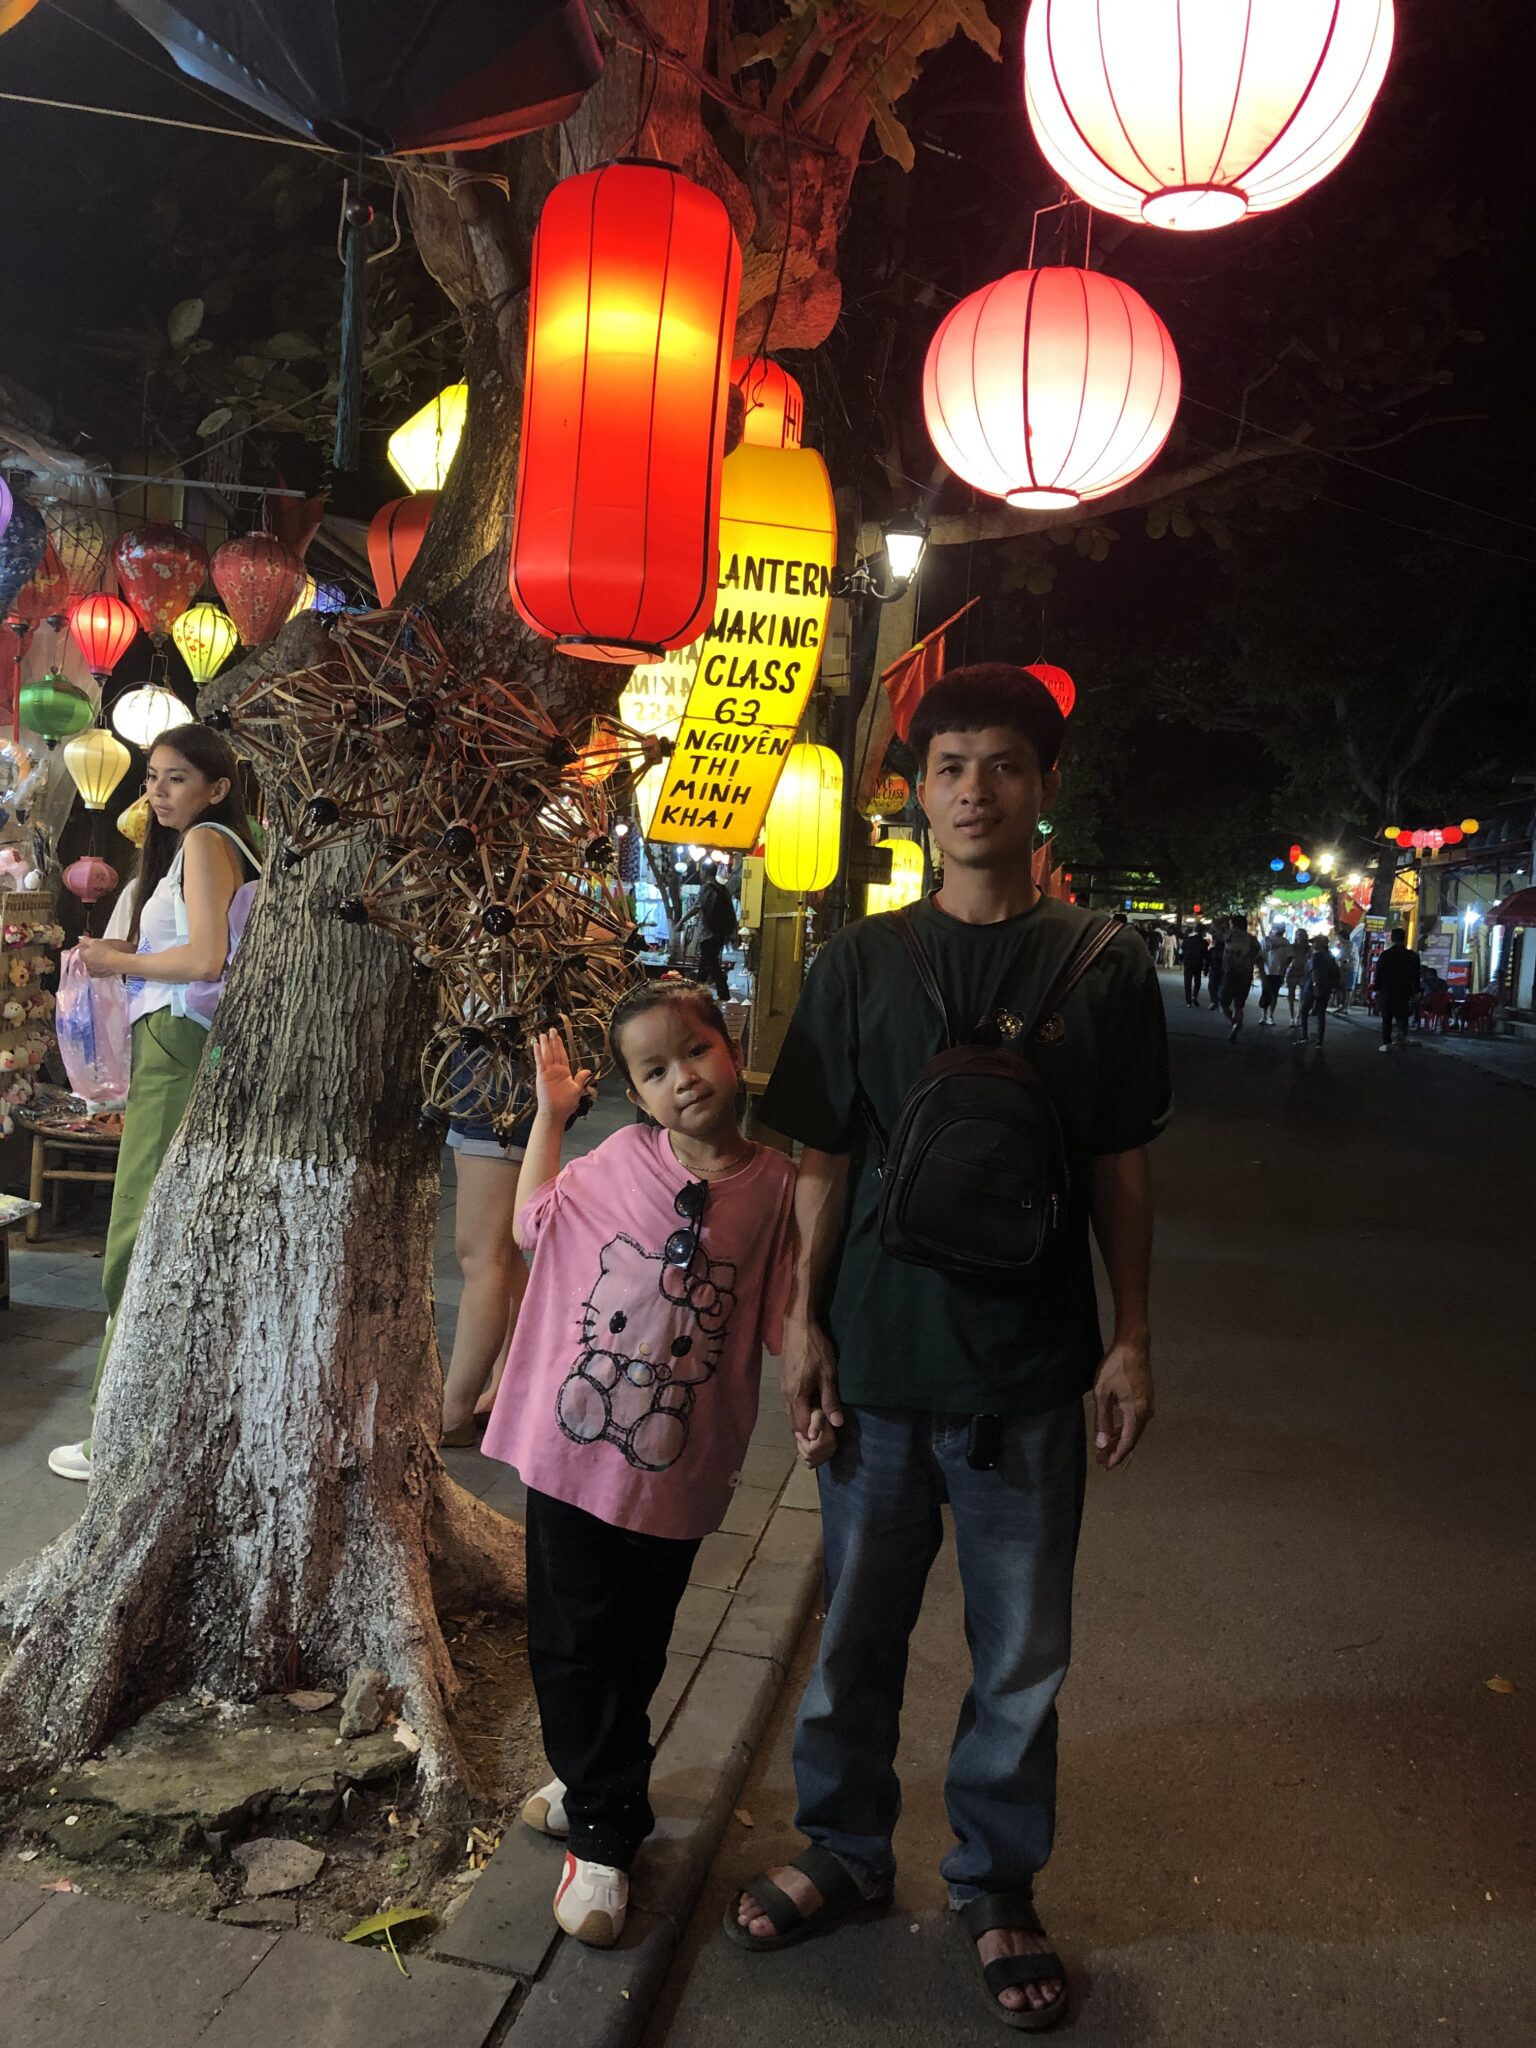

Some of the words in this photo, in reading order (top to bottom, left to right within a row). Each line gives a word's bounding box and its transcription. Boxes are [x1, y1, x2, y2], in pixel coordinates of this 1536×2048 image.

[703, 608, 819, 648] MAKING
[704, 654, 801, 694] CLASS
[715, 697, 761, 727] 63
[690, 755, 740, 782] THỊ
[669, 779, 752, 805] MINH
[661, 805, 734, 830] KHAI
